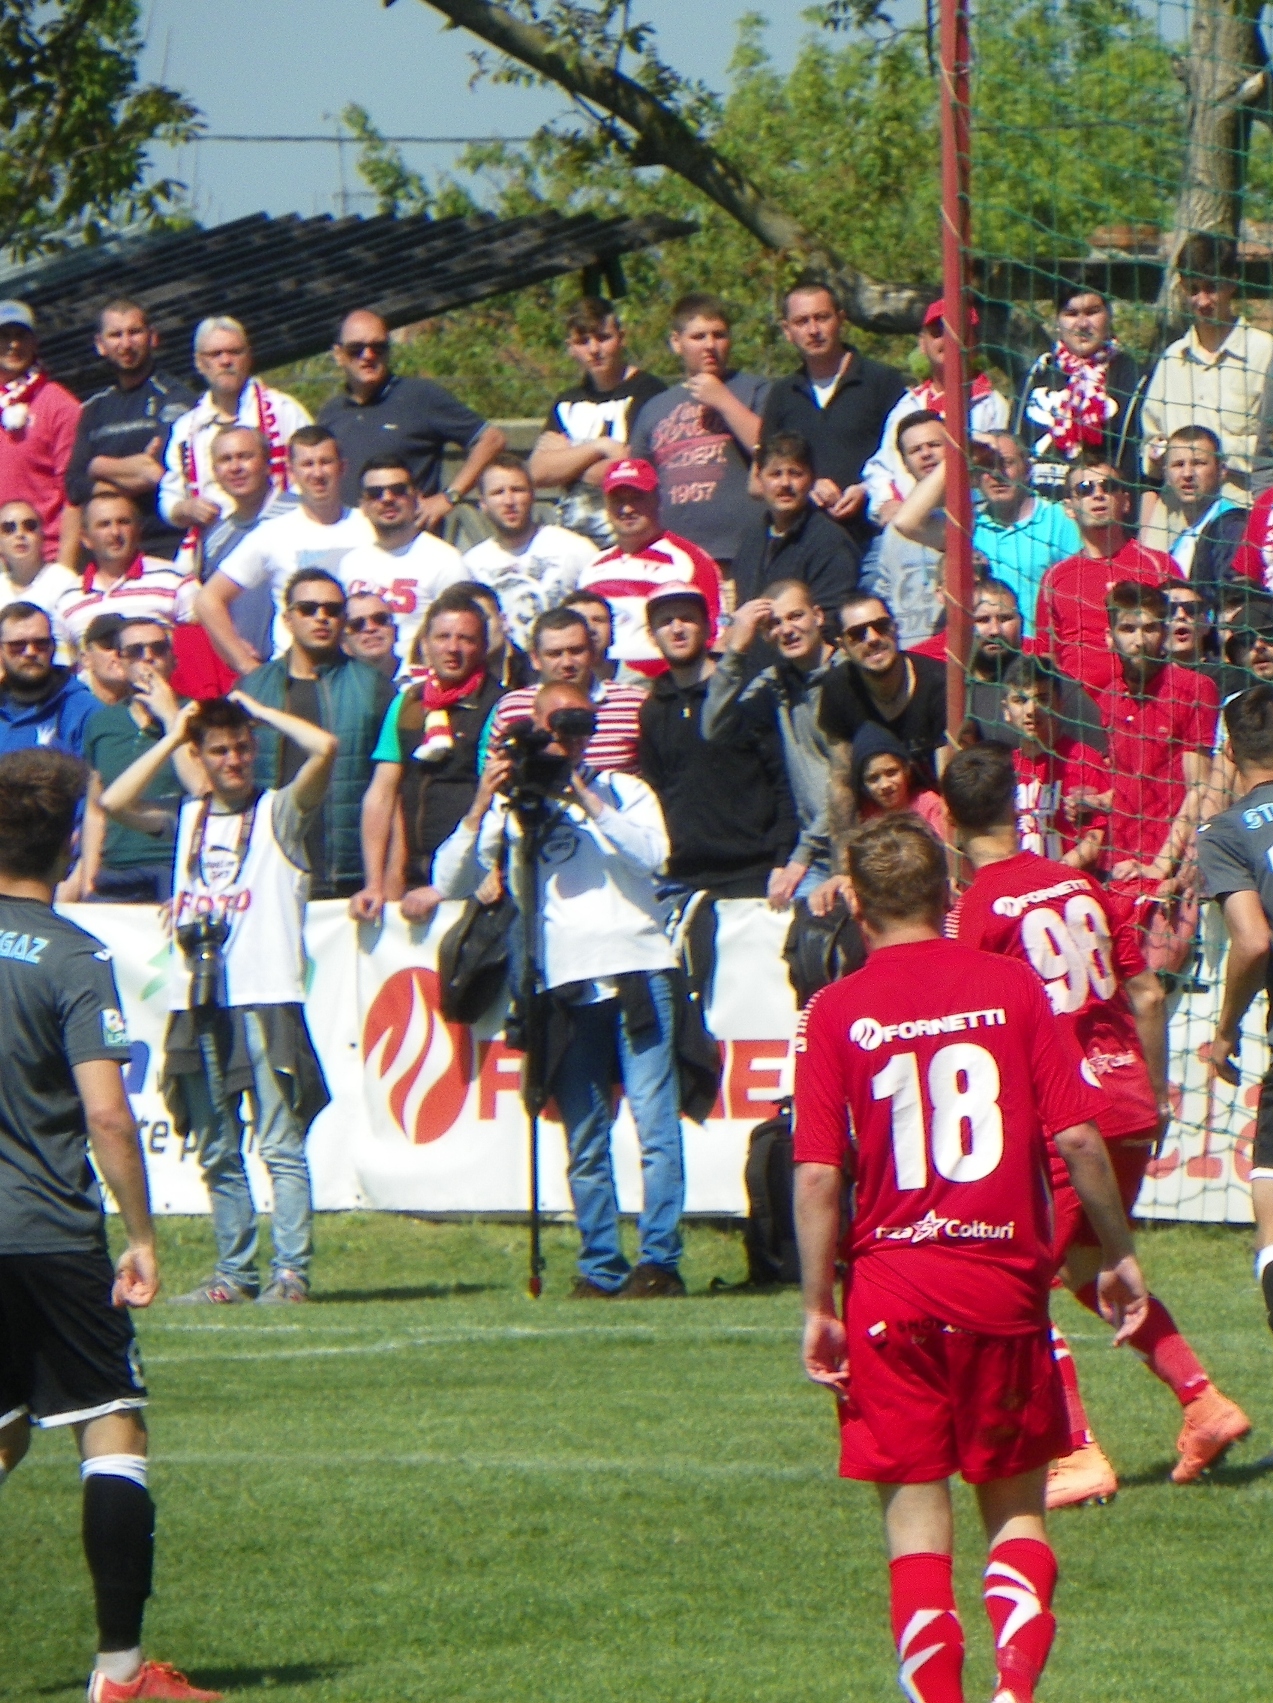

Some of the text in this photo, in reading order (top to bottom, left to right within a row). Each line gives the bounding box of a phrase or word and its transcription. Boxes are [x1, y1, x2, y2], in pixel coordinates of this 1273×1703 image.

[175, 888, 252, 921] FOTO
[1021, 894, 1118, 1016] 98
[882, 1008, 1006, 1043] FORNETTI
[871, 1042, 1004, 1191] 18
[944, 1219, 1016, 1241] Colturi
